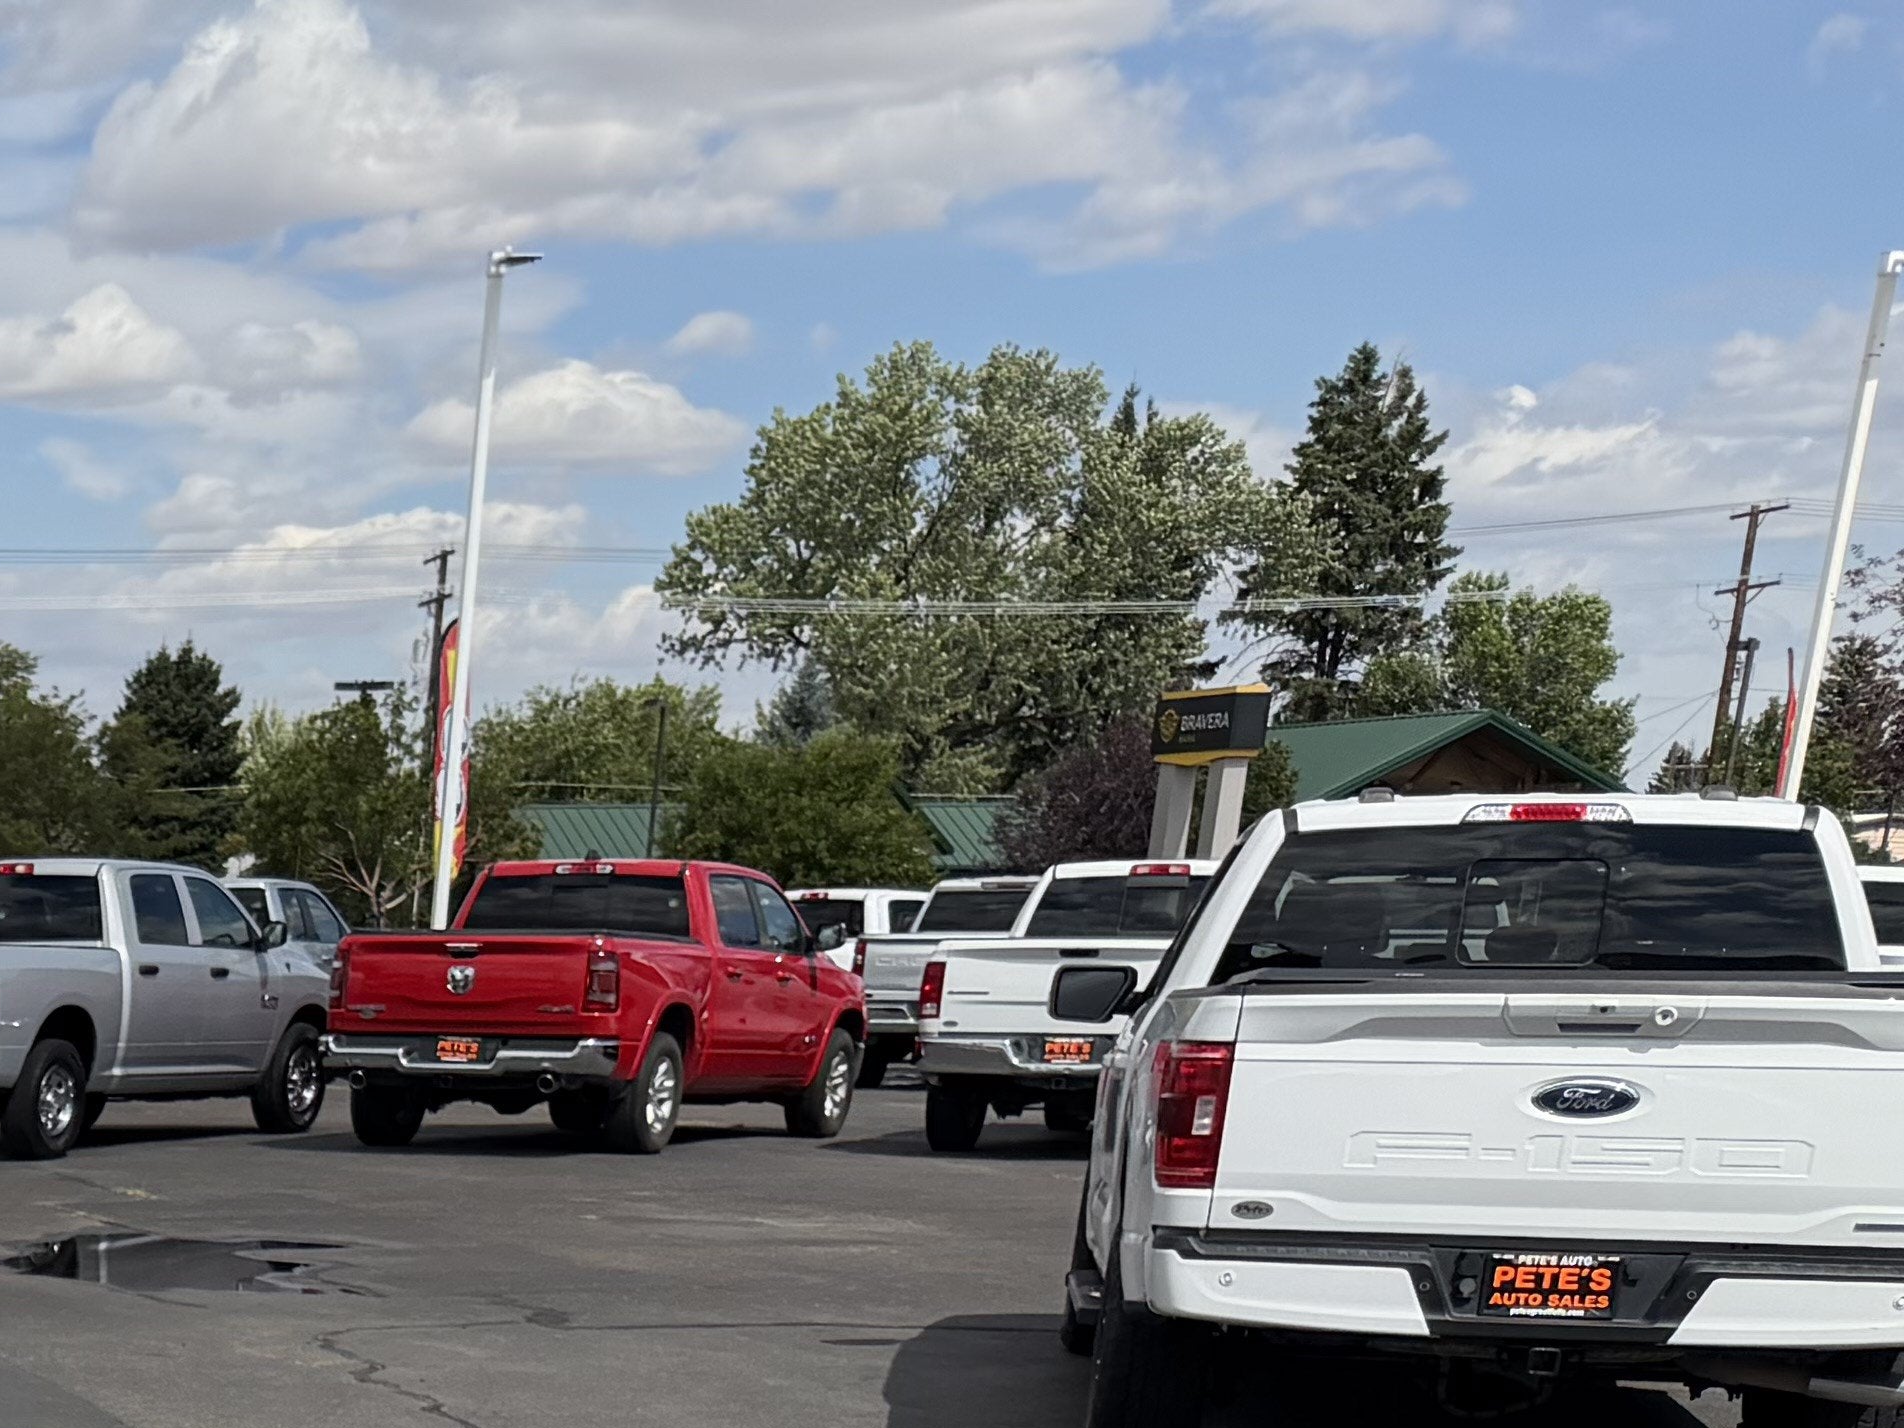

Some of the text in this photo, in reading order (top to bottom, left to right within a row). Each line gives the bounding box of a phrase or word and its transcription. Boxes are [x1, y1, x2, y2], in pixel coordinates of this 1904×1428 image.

[1180, 711, 1230, 732] BRAVERA
[1555, 1086, 1616, 1114] Ford
[1342, 1130, 1816, 1179] F-150
[1518, 1254, 1594, 1267] PETE'S AUTO
[1492, 1265, 1612, 1292] PETE'S
[1488, 1292, 1610, 1309] AUTO SALES
